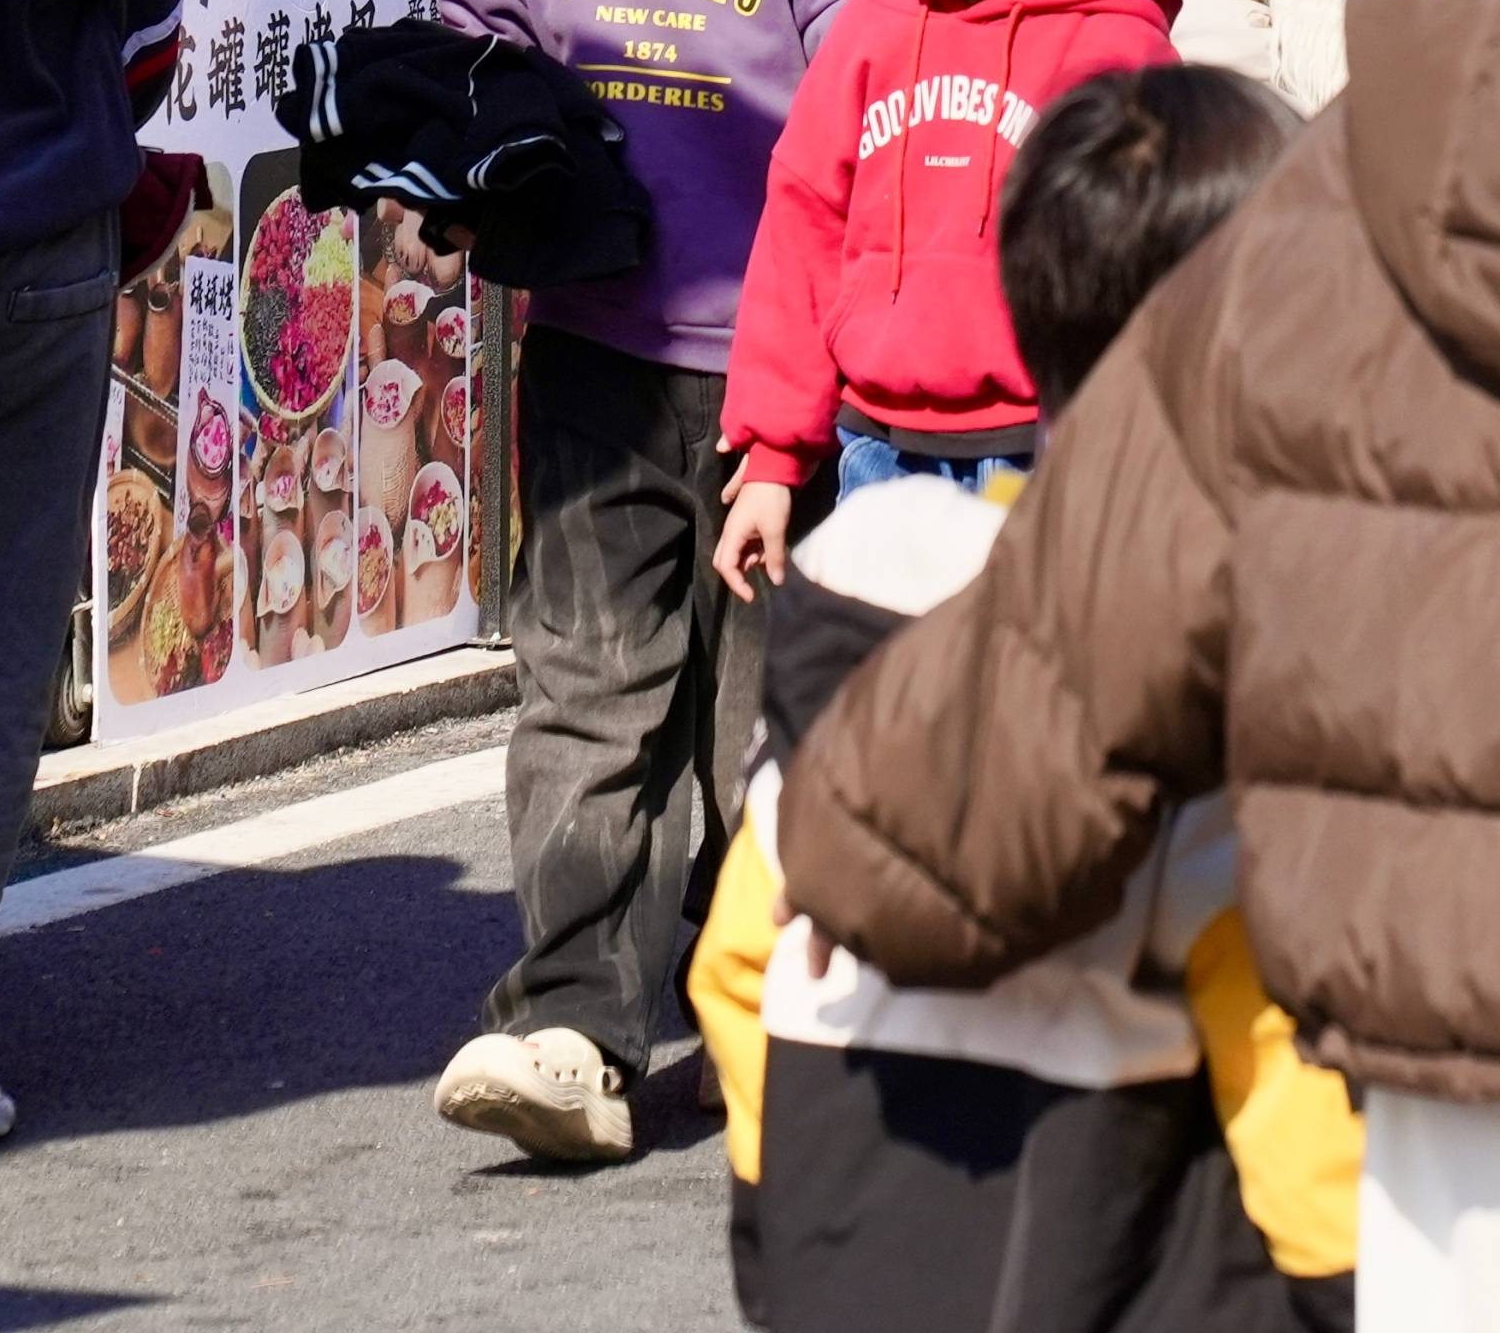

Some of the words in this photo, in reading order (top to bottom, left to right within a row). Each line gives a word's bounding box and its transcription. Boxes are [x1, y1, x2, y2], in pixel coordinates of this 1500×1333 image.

[595, 4, 647, 26] NEW
[652, 8, 707, 31] CARE
[624, 39, 678, 63] 1874
[582, 79, 726, 113] ORDERLES
